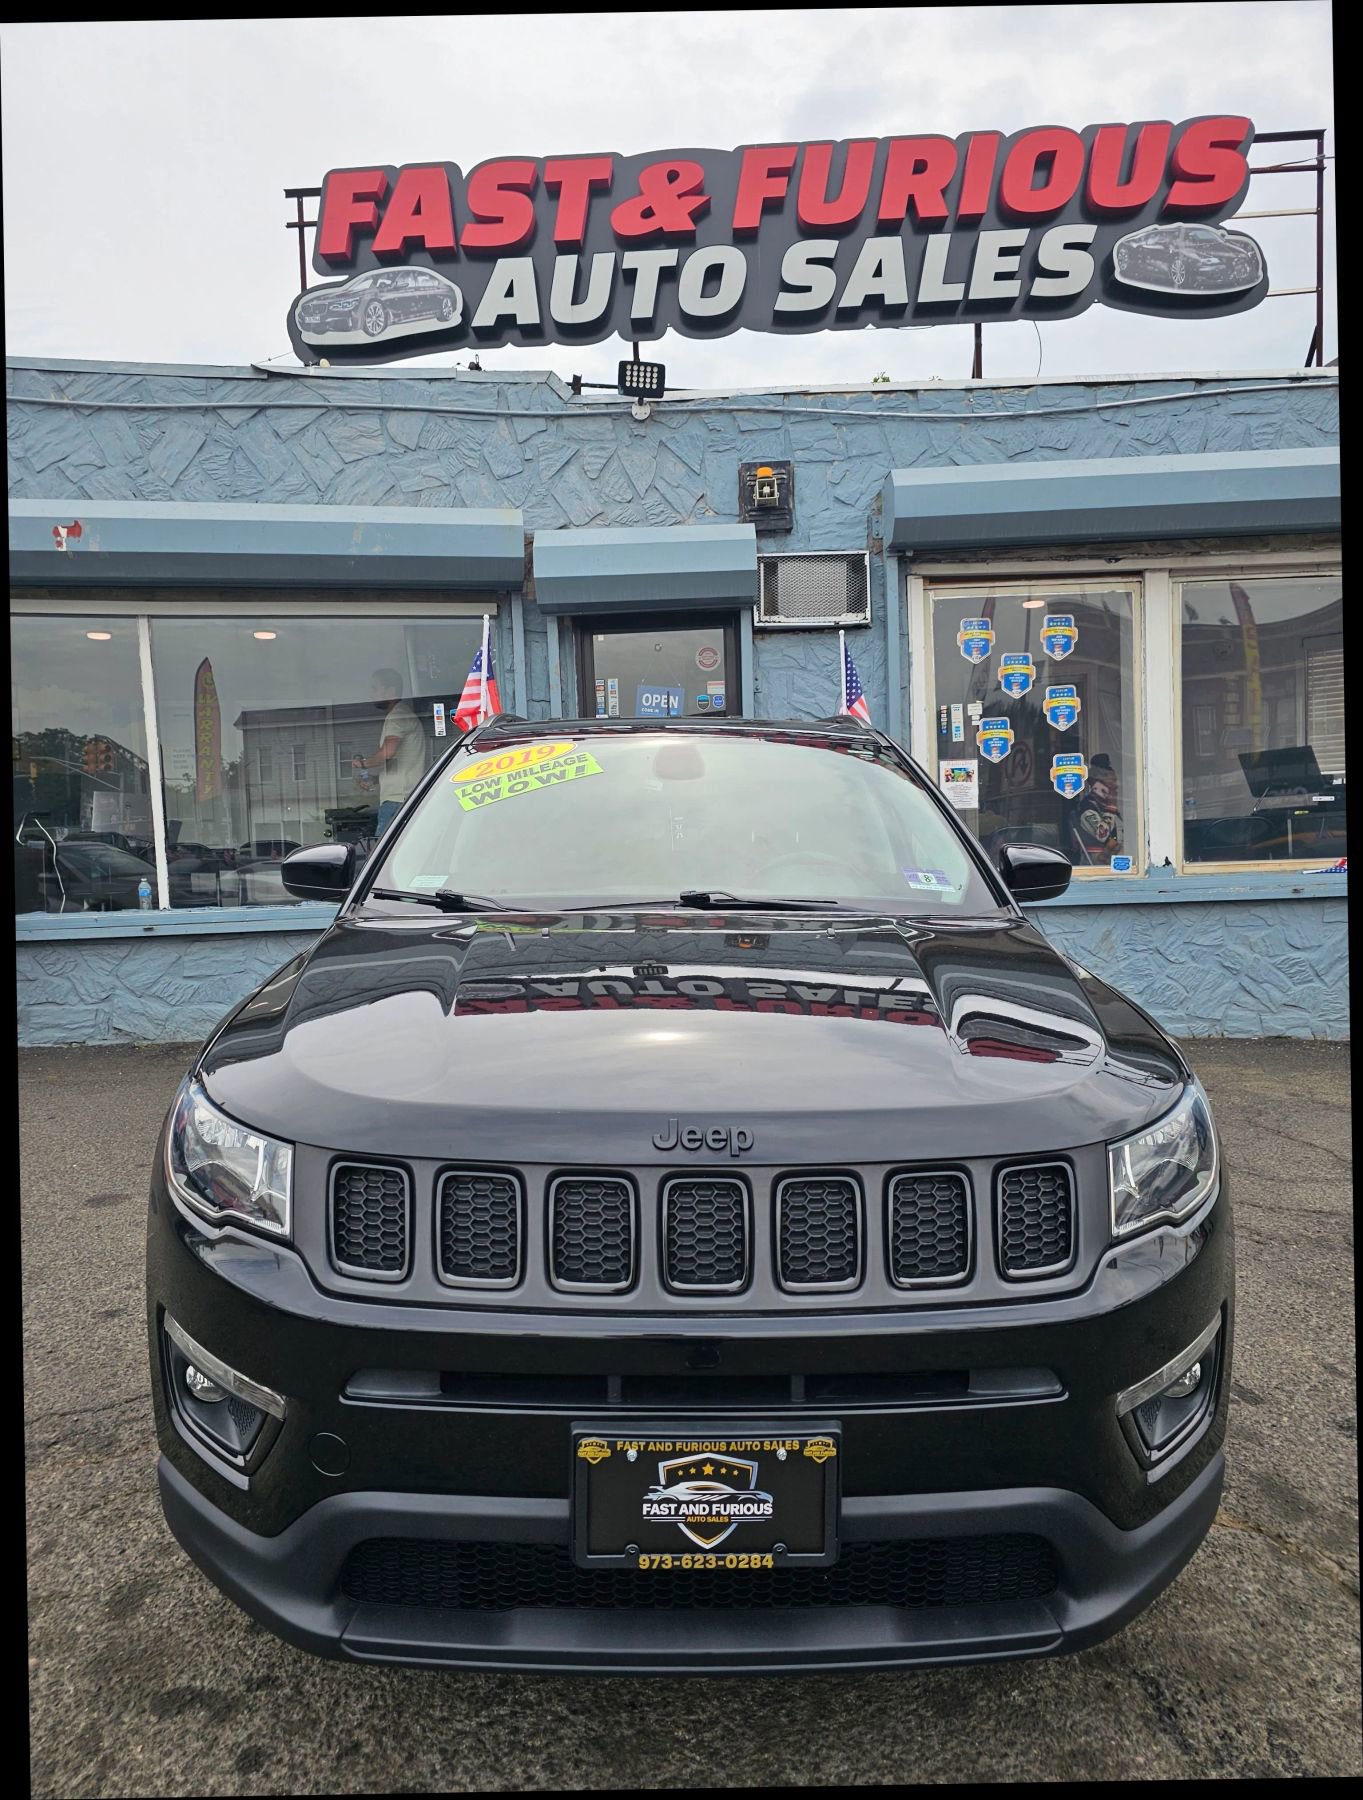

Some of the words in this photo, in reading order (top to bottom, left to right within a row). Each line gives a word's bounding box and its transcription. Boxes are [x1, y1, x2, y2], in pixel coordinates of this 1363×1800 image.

[319, 157, 614, 261] FAST
[609, 160, 712, 242] &
[731, 116, 1253, 237] FURIOUS
[471, 244, 748, 330] AUTO
[773, 223, 1099, 313] SALES
[641, 693, 679, 709] OPEN
[460, 777, 501, 798] LOW
[507, 753, 588, 783] MILEAGE
[475, 744, 556, 778] 2019
[651, 1118, 755, 1158] Jeep
[616, 1440, 646, 1451] FAST
[647, 1441, 673, 1452] AND
[675, 1441, 727, 1452] FURIOUS
[729, 1441, 761, 1452] AUTO
[763, 1440, 800, 1451] SALES
[642, 1503, 677, 1515] FAST
[678, 1503, 710, 1515] AND
[712, 1502, 773, 1515] FURIOUS
[638, 1553, 774, 1569] 973-623-0284
